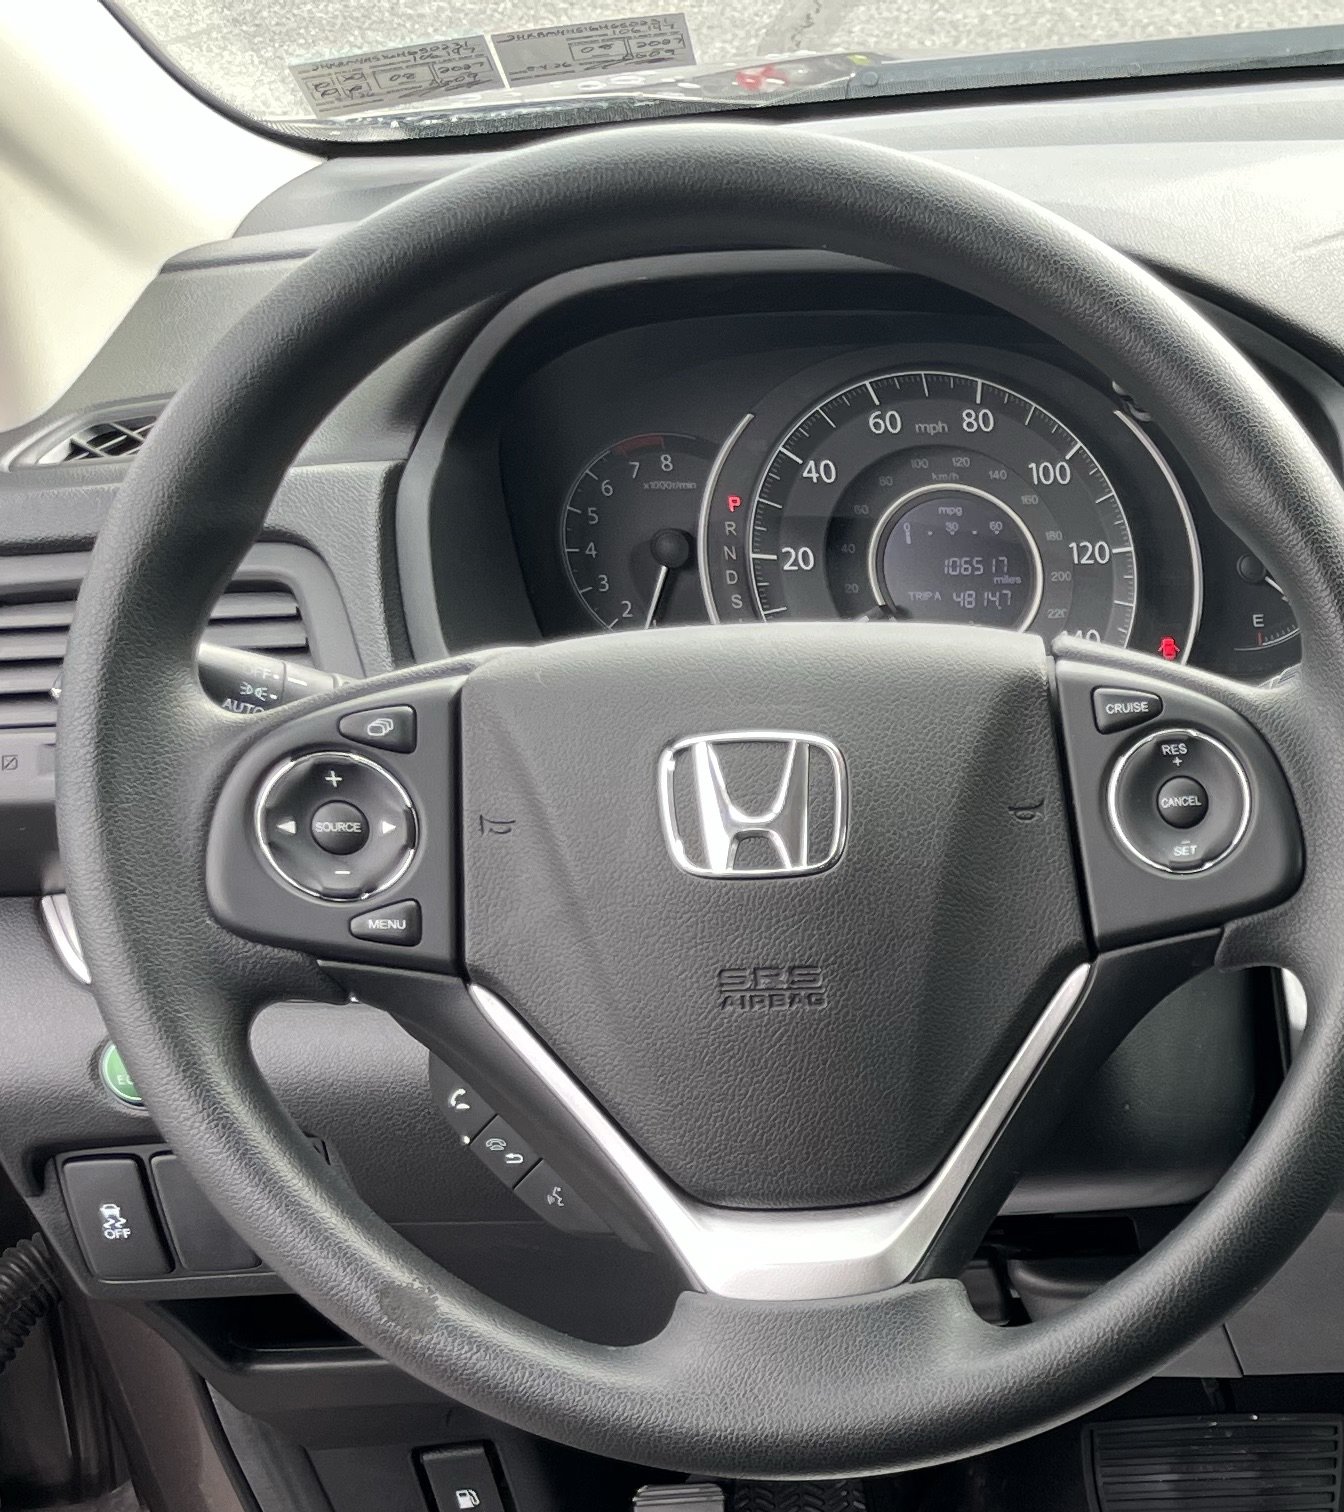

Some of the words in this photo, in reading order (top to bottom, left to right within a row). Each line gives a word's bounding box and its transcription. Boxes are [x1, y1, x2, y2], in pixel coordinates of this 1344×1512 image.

[868, 410, 901, 434] 60
[915, 420, 949, 436] mph
[962, 408, 995, 432] 80
[628, 461, 640, 479] 7
[660, 453, 674, 472] 8
[802, 459, 836, 484] 40
[1028, 461, 1071, 485] 100
[600, 480, 614, 497] 6
[727, 496, 742, 512] P
[938, 505, 963, 517] mpg
[587, 507, 599, 525] 5
[725, 521, 737, 536] R
[585, 542, 598, 559] 4
[724, 546, 737, 560] N
[1068, 541, 1111, 565] 120
[782, 547, 814, 571] 20
[944, 556, 1009, 576] 106517
[598, 575, 609, 592] 3
[726, 570, 739, 585] D
[993, 576, 1022, 585] miles
[621, 600, 634, 618] 2
[731, 594, 743, 609] S
[1253, 614, 1265, 628] E
[1105, 701, 1149, 714] CRUISE
[1161, 743, 1188, 755] RES
[1160, 795, 1202, 808] CANCEL
[315, 822, 361, 833] SOURCE
[1173, 844, 1198, 856] SET
[368, 919, 406, 930] MENU
[719, 965, 822, 989] SRS
[720, 992, 828, 1010] AIRBAG
[104, 1227, 131, 1240] OFF
